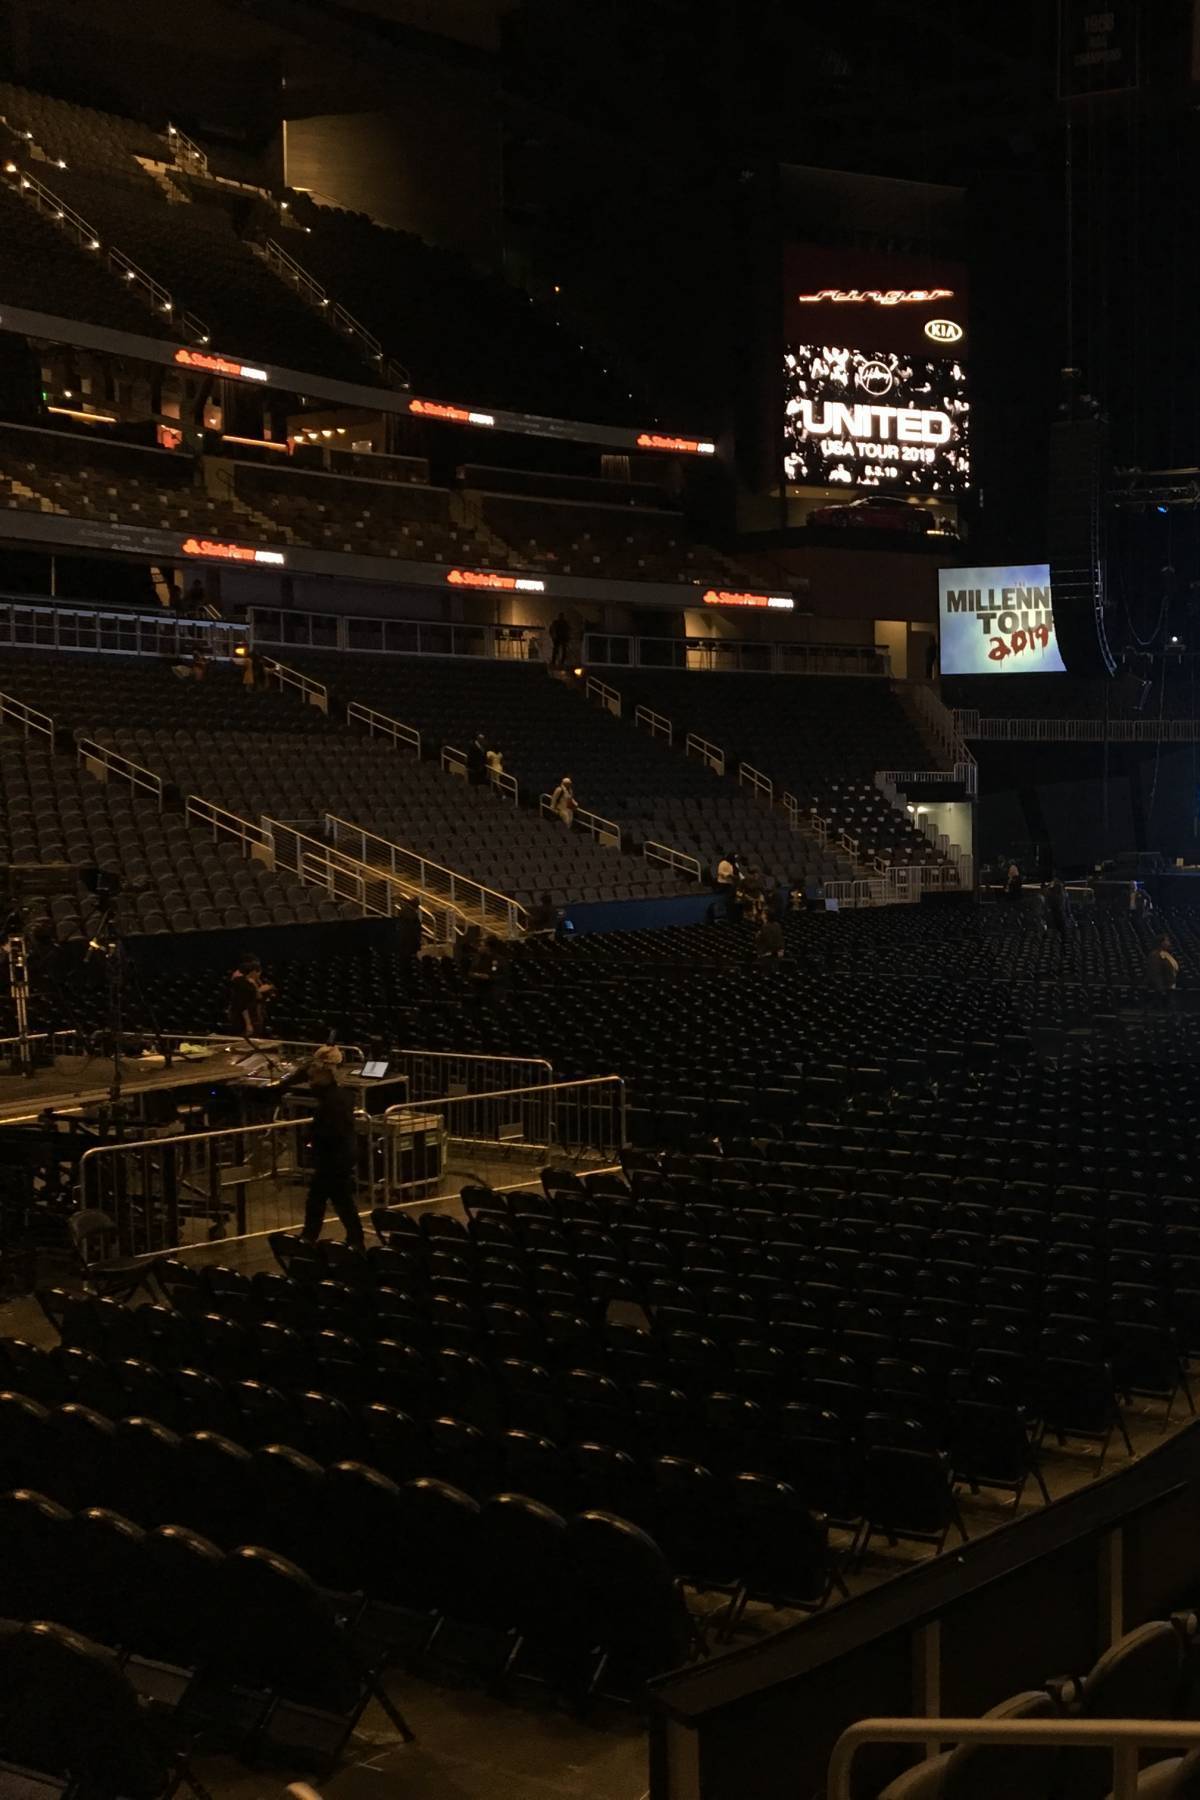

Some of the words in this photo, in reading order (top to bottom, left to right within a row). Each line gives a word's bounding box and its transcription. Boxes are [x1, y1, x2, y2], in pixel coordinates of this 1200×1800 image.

[930, 324, 956, 338] KIA
[801, 400, 951, 444] UNITED
[856, 442, 899, 460] TOUR
[947, 587, 1051, 612] MILLENN
[988, 624, 1029, 660] 2019
